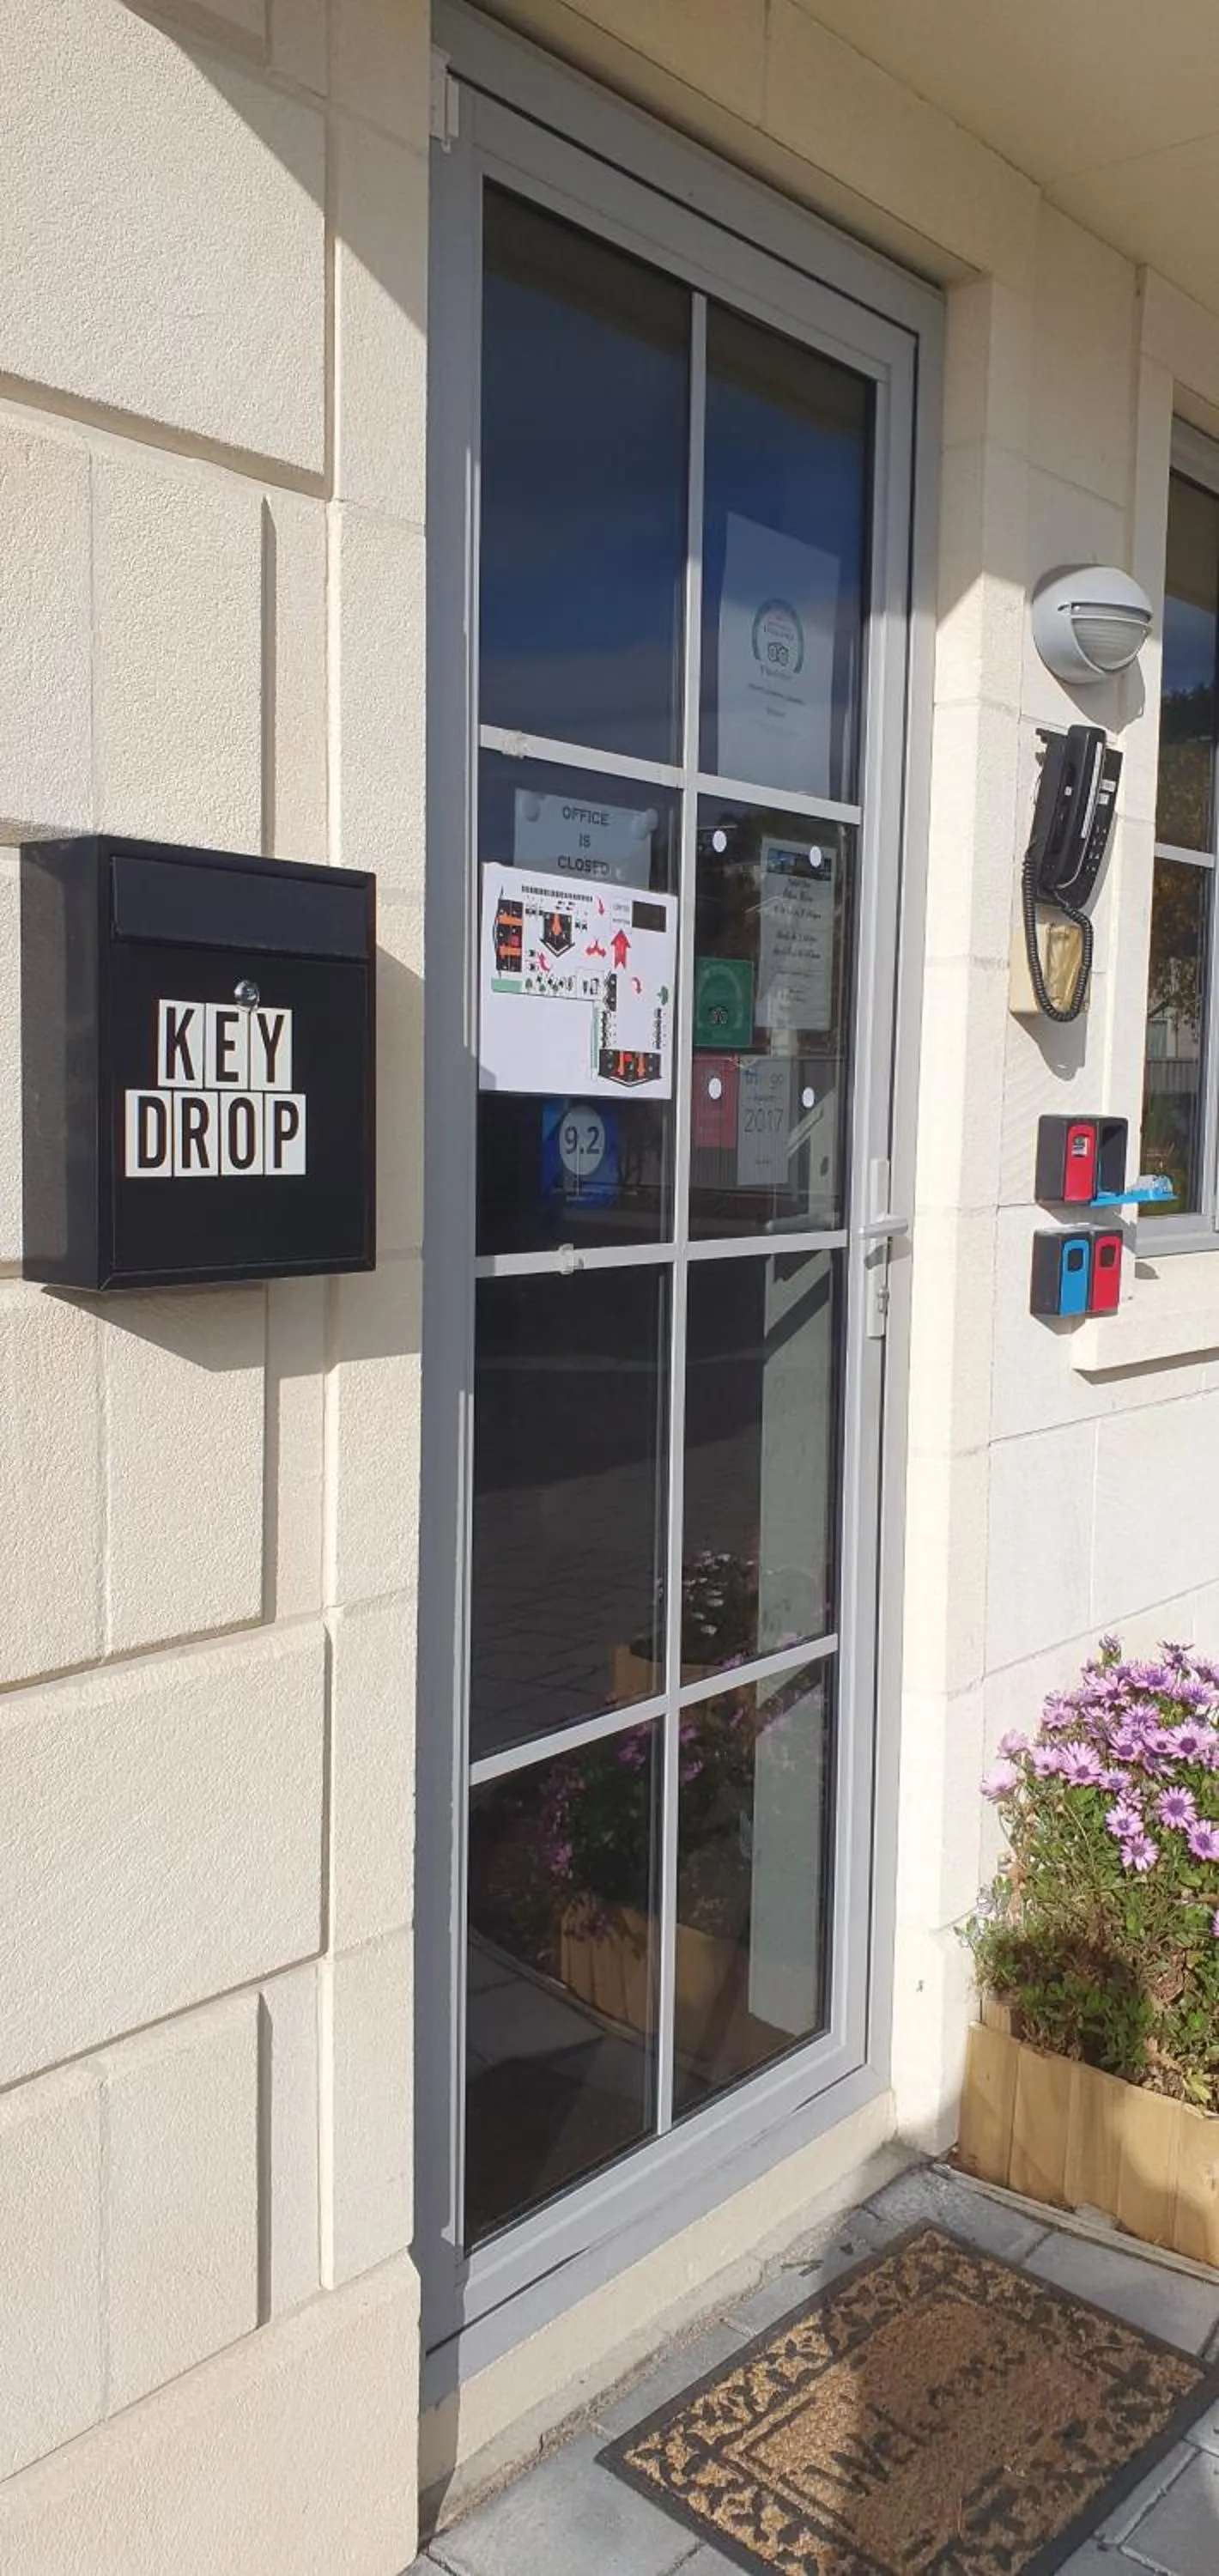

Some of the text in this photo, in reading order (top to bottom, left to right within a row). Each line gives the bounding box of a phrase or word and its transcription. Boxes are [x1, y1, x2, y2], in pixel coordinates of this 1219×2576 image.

[562, 805, 610, 826] OFFICE
[579, 833, 591, 848] IS
[557, 855, 610, 876] CLOSED
[166, 1006, 285, 1084] KEY
[137, 1096, 300, 1170] DROP
[744, 1108, 785, 1133] 2017
[564, 1126, 600, 1155] 9.2
[802, 2337, 1027, 2496] Welcome
